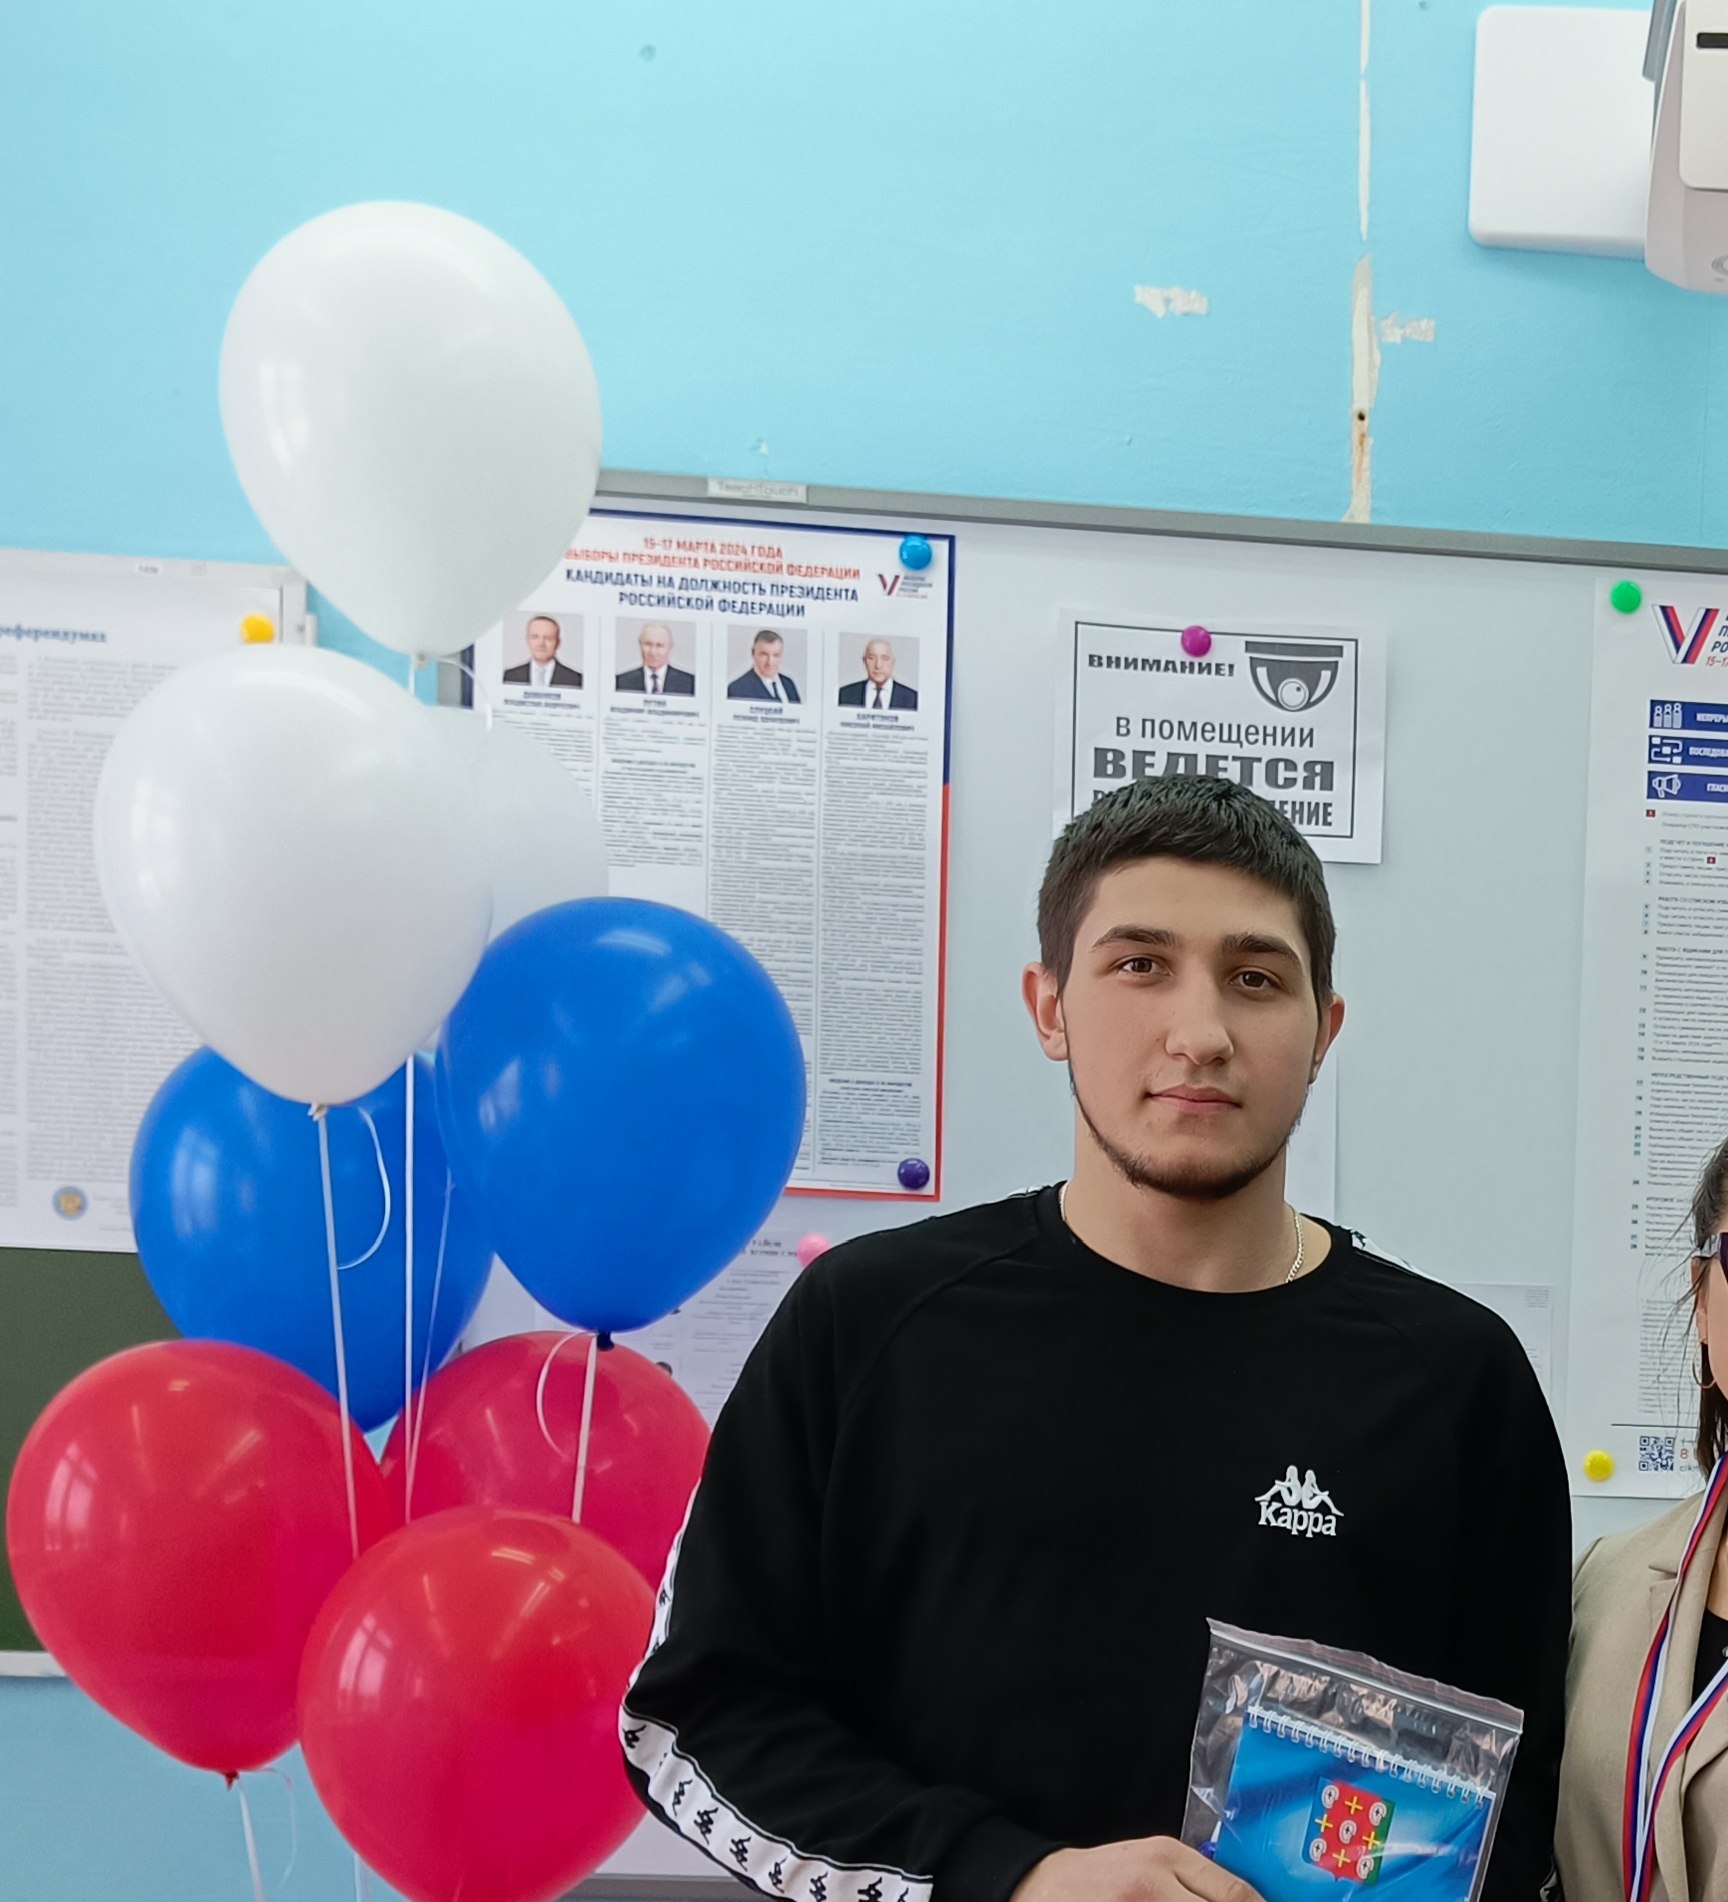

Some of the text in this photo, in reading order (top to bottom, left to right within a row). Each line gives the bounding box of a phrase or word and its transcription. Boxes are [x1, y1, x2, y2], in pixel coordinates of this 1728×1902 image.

[677, 541, 716, 554] МАРТА
[751, 545, 783, 560] ГОДА
[622, 552, 700, 570] ПРЕЗИДЕНТА
[703, 557, 783, 574] РОССИЙСКОЙ
[787, 563, 860, 580] ФЕДЕРАЦИИ
[566, 569, 859, 602] КАНДИДАТЫ НА ДОЛЖНОСТЬ ПРЕЗИДЕНТА
[619, 592, 805, 618] РОССИЙСКОЙ ФЕДЕРАЦИИ
[1088, 653, 1235, 677] ВНИМАНИЕ!
[1141, 718, 1314, 748] помещении
[1093, 747, 1335, 791] ВЕДЕТСЯ
[1680, 1448, 1688, 1459] 8
[1258, 1501, 1337, 1538] Kappa
